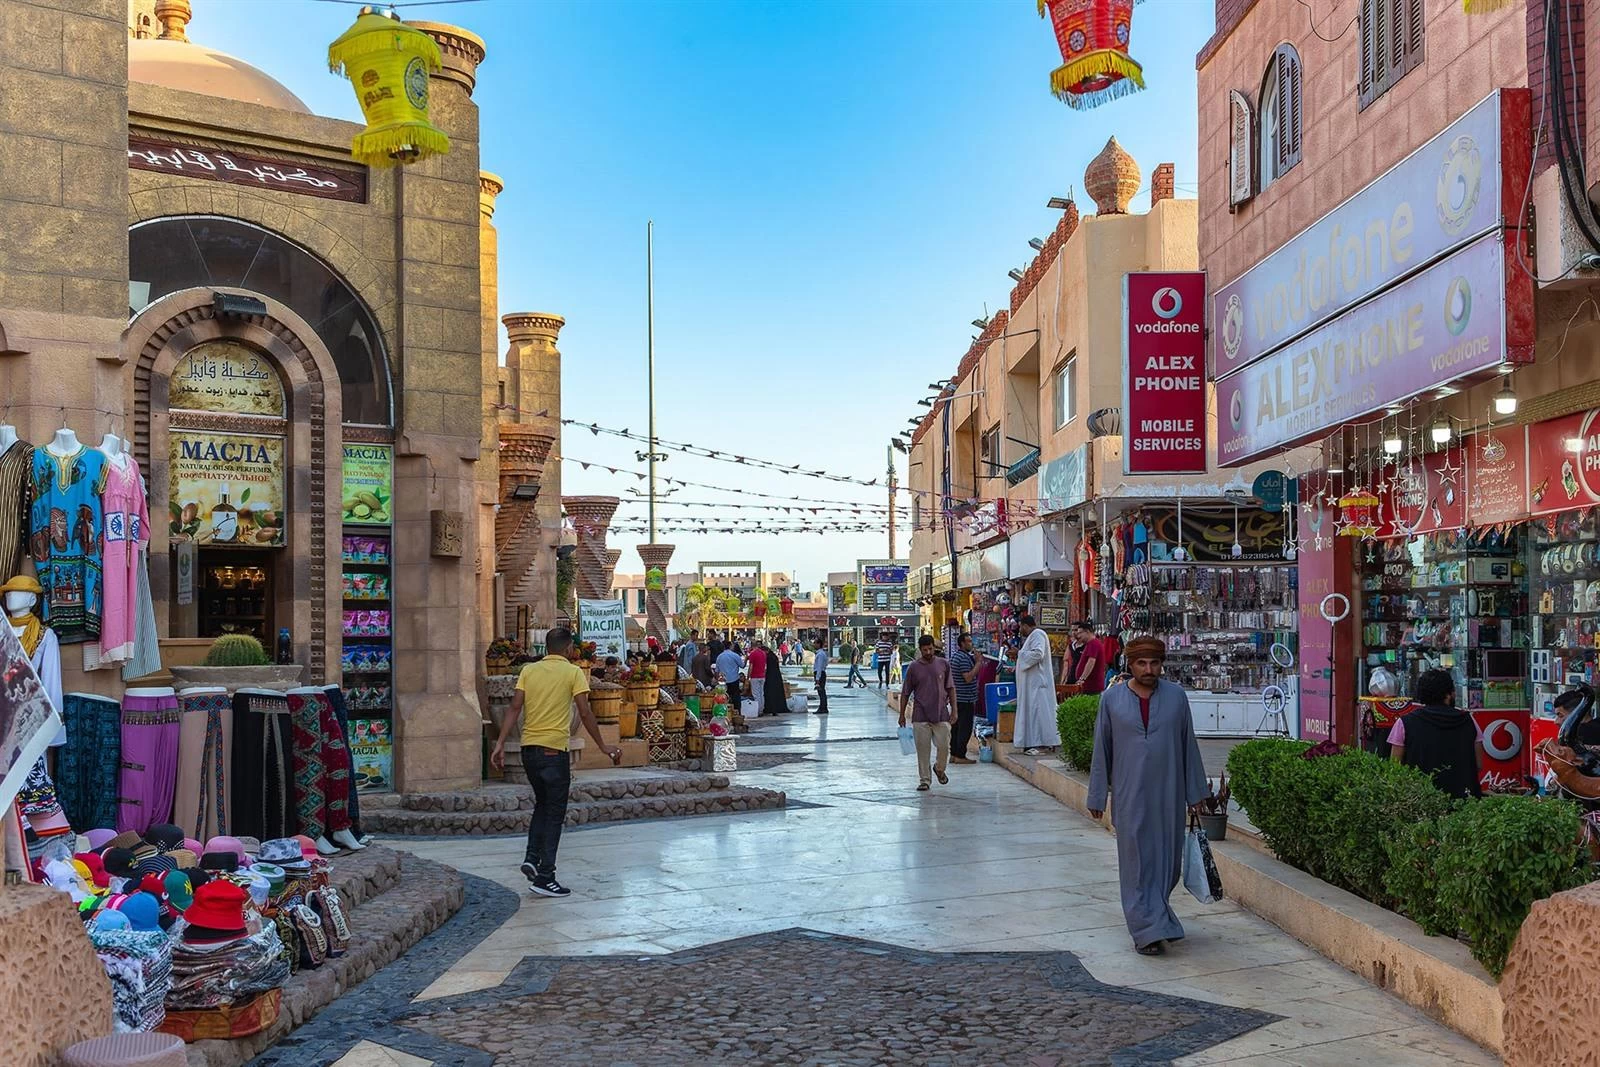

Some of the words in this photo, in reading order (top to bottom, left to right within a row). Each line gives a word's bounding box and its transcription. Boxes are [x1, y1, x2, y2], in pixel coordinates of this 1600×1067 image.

[128, 148, 216, 170] قابي
[1254, 203, 1414, 341] vodafone
[1136, 321, 1199, 333] vodafone
[1430, 335, 1489, 373] vodafone
[181, 355, 216, 381] قابيل
[222, 359, 269, 380] مكتبة
[1145, 356, 1195, 370] ALEX
[1135, 377, 1200, 390] PHONE
[1141, 419, 1194, 432] MOBILE
[1286, 406, 1321, 433] MOBILE
[180, 440, 271, 464] МАСЛА
[1134, 438, 1201, 451] SERVICES
[343, 448, 387, 460] МАСЛА
[180, 463, 210, 471] NATURAL
[236, 465, 272, 473] PERFUMES
[1306, 578, 1328, 594] ALEX
[1301, 601, 1333, 617] PHOE
[583, 620, 621, 631] МАСЛА
[1305, 718, 1330, 735] MOBILE
